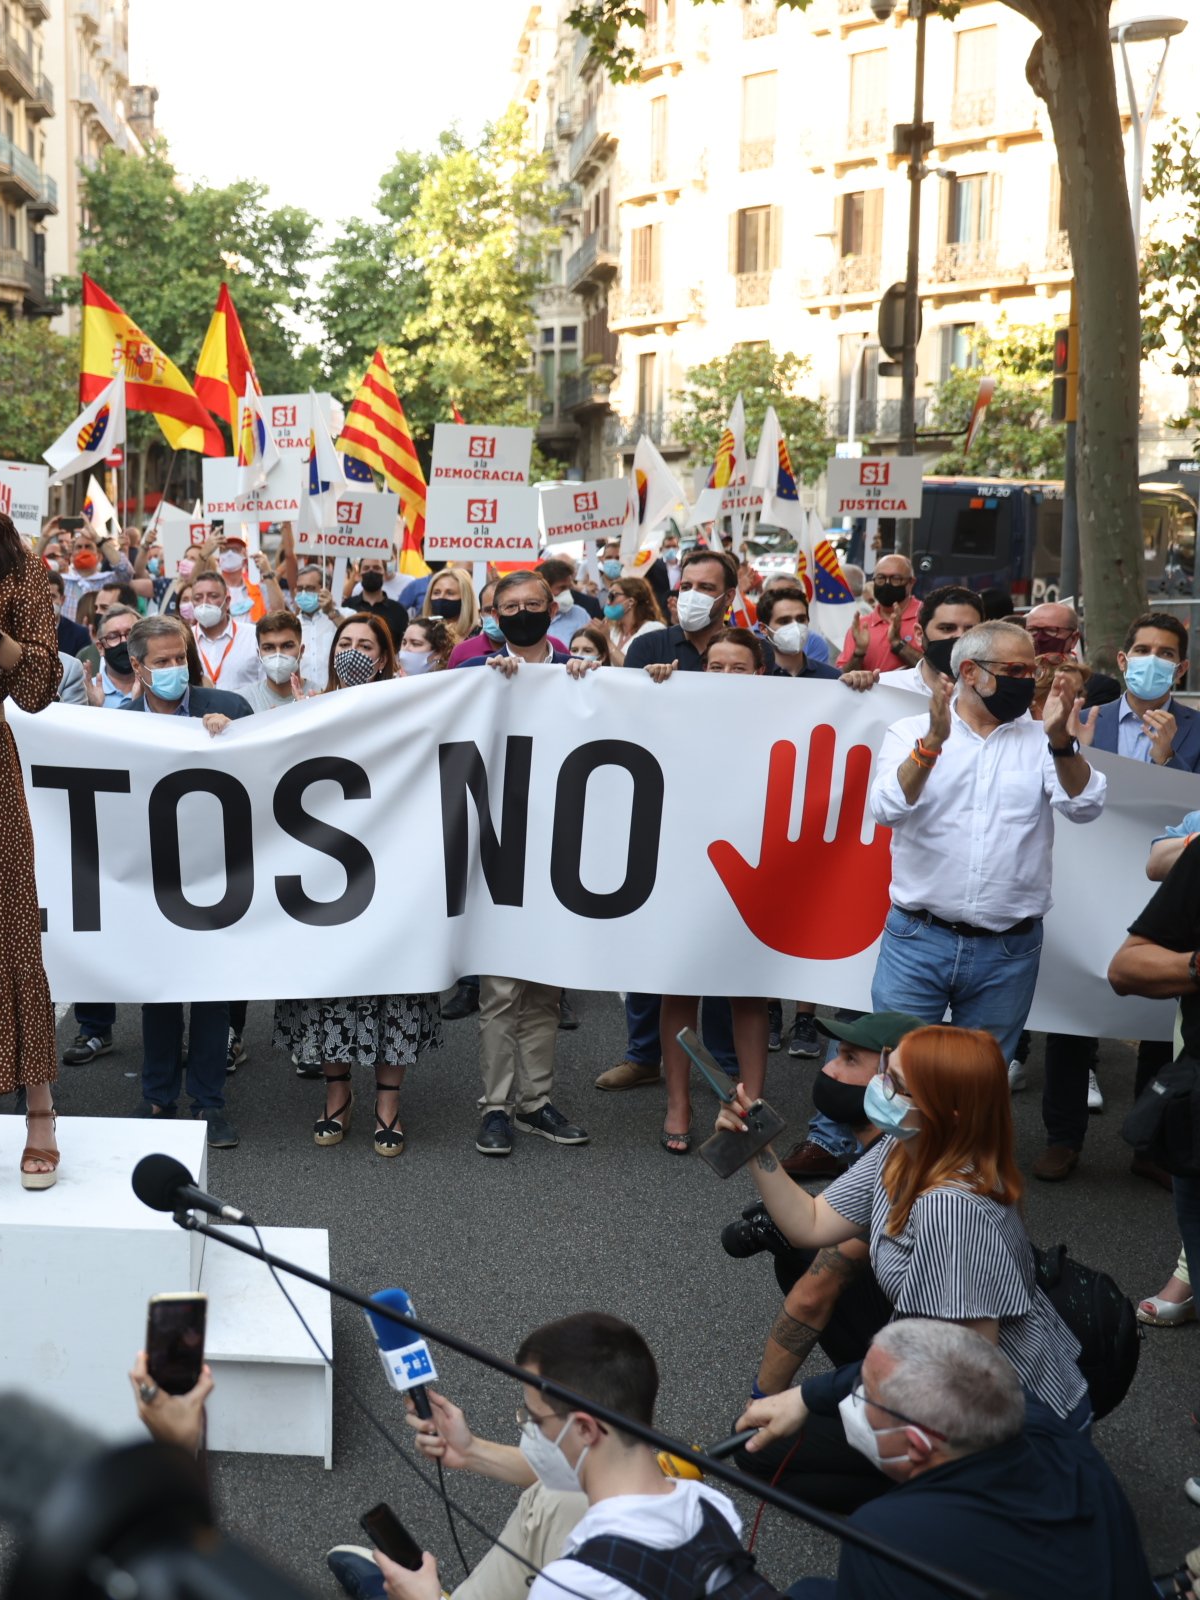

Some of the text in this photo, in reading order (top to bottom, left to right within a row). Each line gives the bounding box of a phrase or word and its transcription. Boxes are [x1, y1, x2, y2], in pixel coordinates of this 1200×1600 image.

[274, 406, 294, 425] SÍ
[471, 437, 493, 456] SÍ
[480, 459, 487, 468] la
[435, 467, 524, 482] DEMOCRACIA
[862, 462, 888, 484] SÍ
[873, 487, 881, 496] la
[575, 492, 596, 512] SÍ
[721, 495, 763, 510] STICIA
[838, 499, 907, 512] JUSTICIA
[11, 510, 38, 521] NOMBRE
[338, 502, 359, 522] SÍ
[470, 499, 494, 521] SÍ
[346, 525, 352, 534] la
[473, 525, 489, 535] a la
[299, 532, 388, 549] DMOCRACIA
[429, 536, 533, 549] DEMOCRACIA
[439, 736, 664, 920] NO
